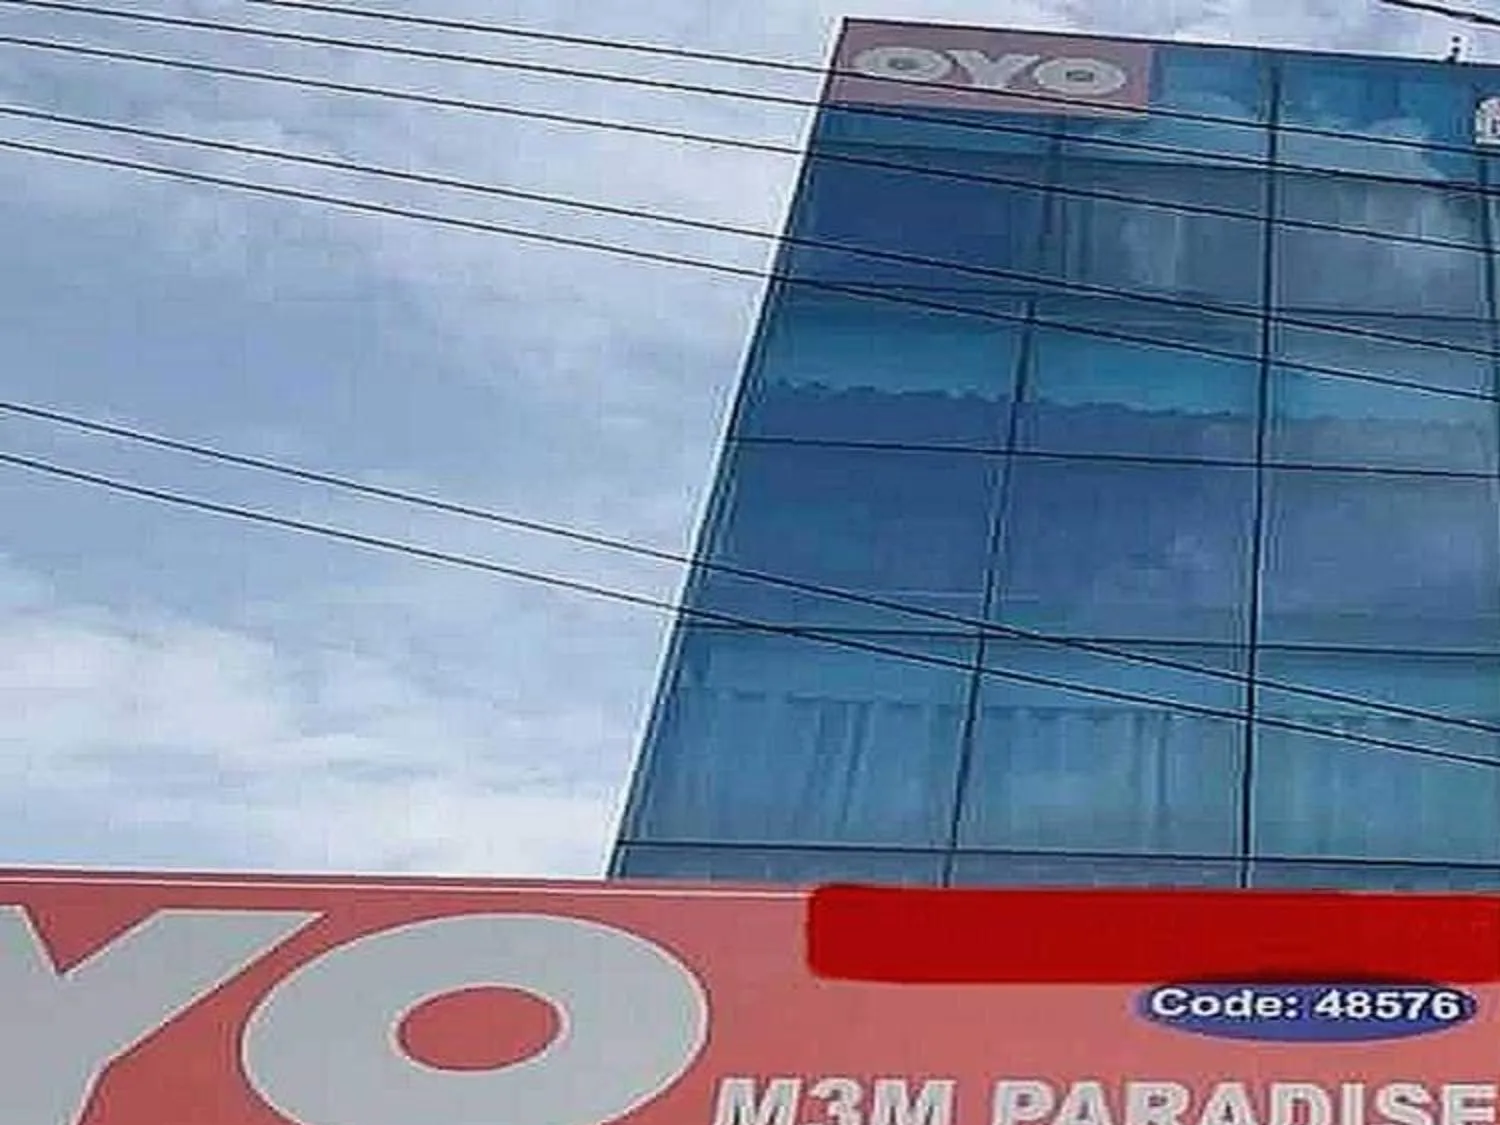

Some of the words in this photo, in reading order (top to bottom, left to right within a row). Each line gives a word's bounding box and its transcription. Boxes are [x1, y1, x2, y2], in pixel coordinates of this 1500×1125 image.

[851, 46, 1127, 96] OYO
[1151, 987, 1300, 1021] Code:
[1313, 987, 1461, 1021] 48576
